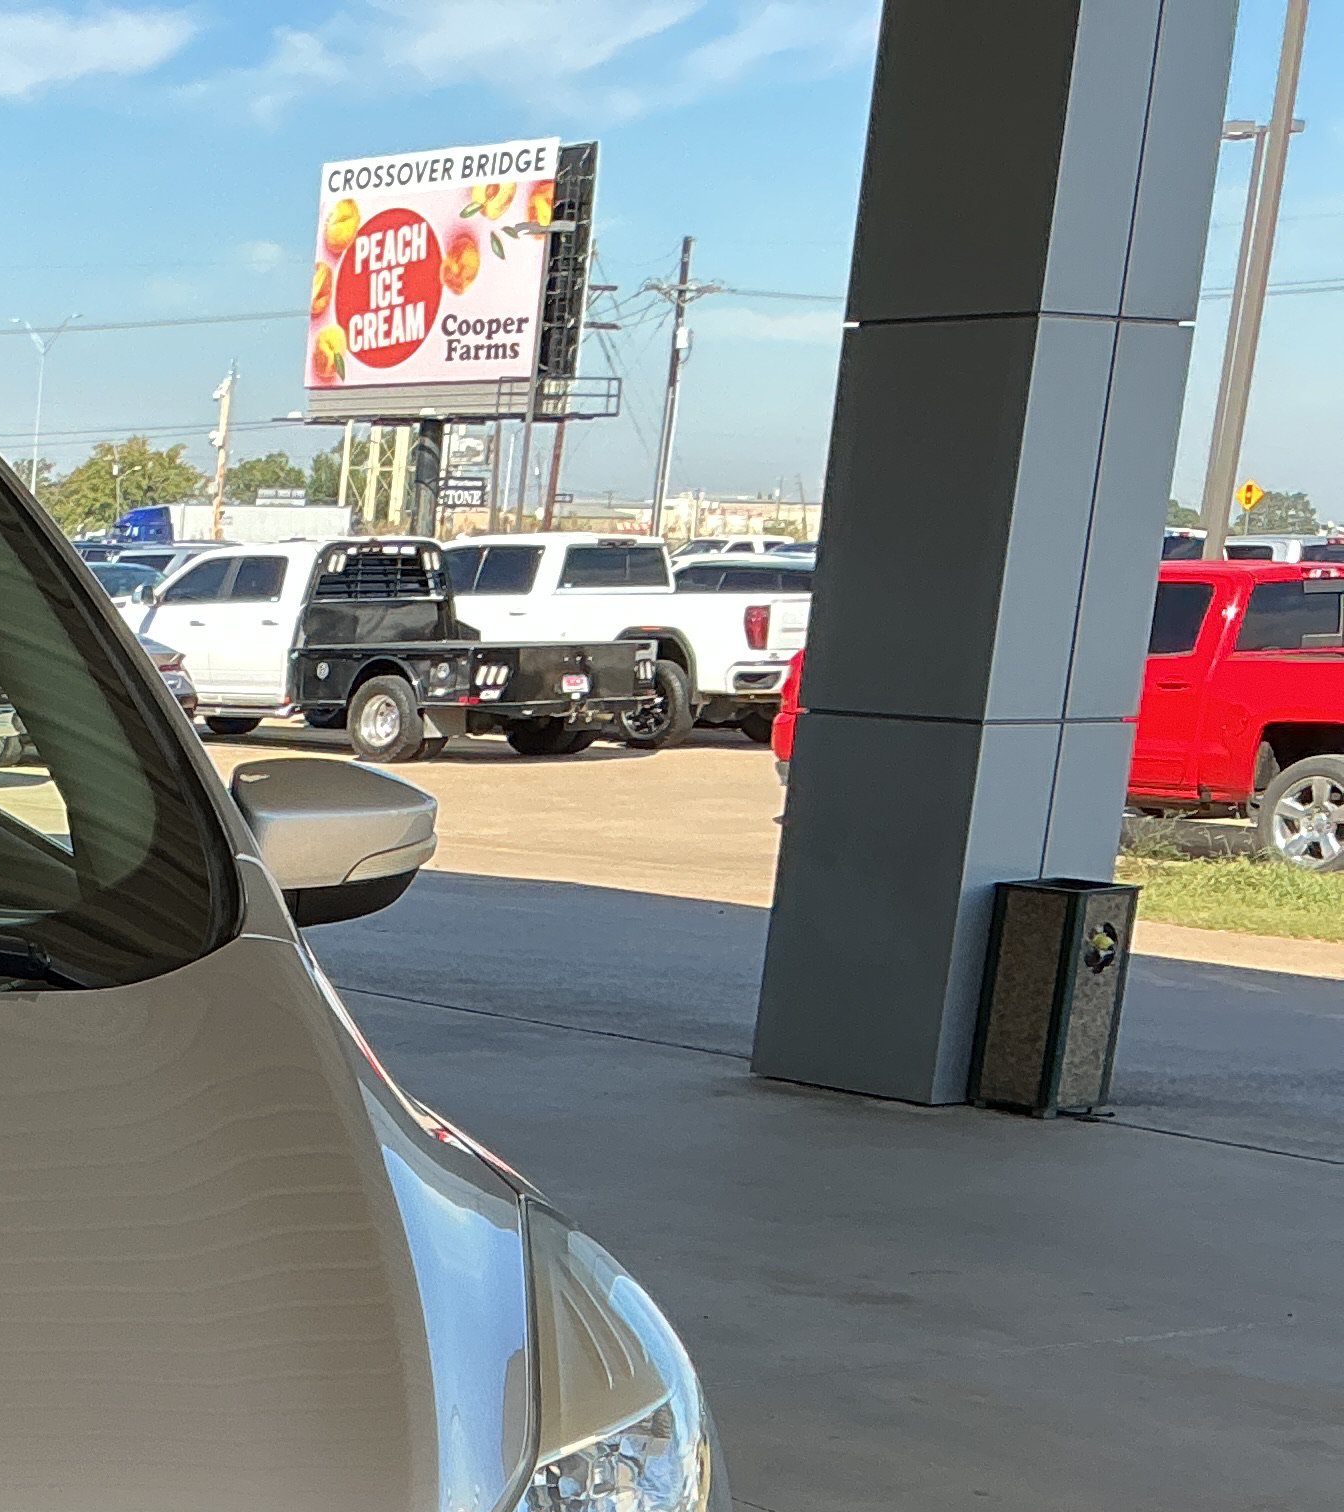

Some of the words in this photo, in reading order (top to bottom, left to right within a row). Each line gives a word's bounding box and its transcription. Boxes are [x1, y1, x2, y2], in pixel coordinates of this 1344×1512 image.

[327, 158, 454, 193] CROSSOVER
[461, 147, 547, 180] BRIDGE
[354, 222, 427, 275] PEACH
[369, 266, 405, 310] ICE
[348, 302, 425, 353] CREAM
[441, 313, 530, 344] Cooper
[444, 338, 520, 362] Farms
